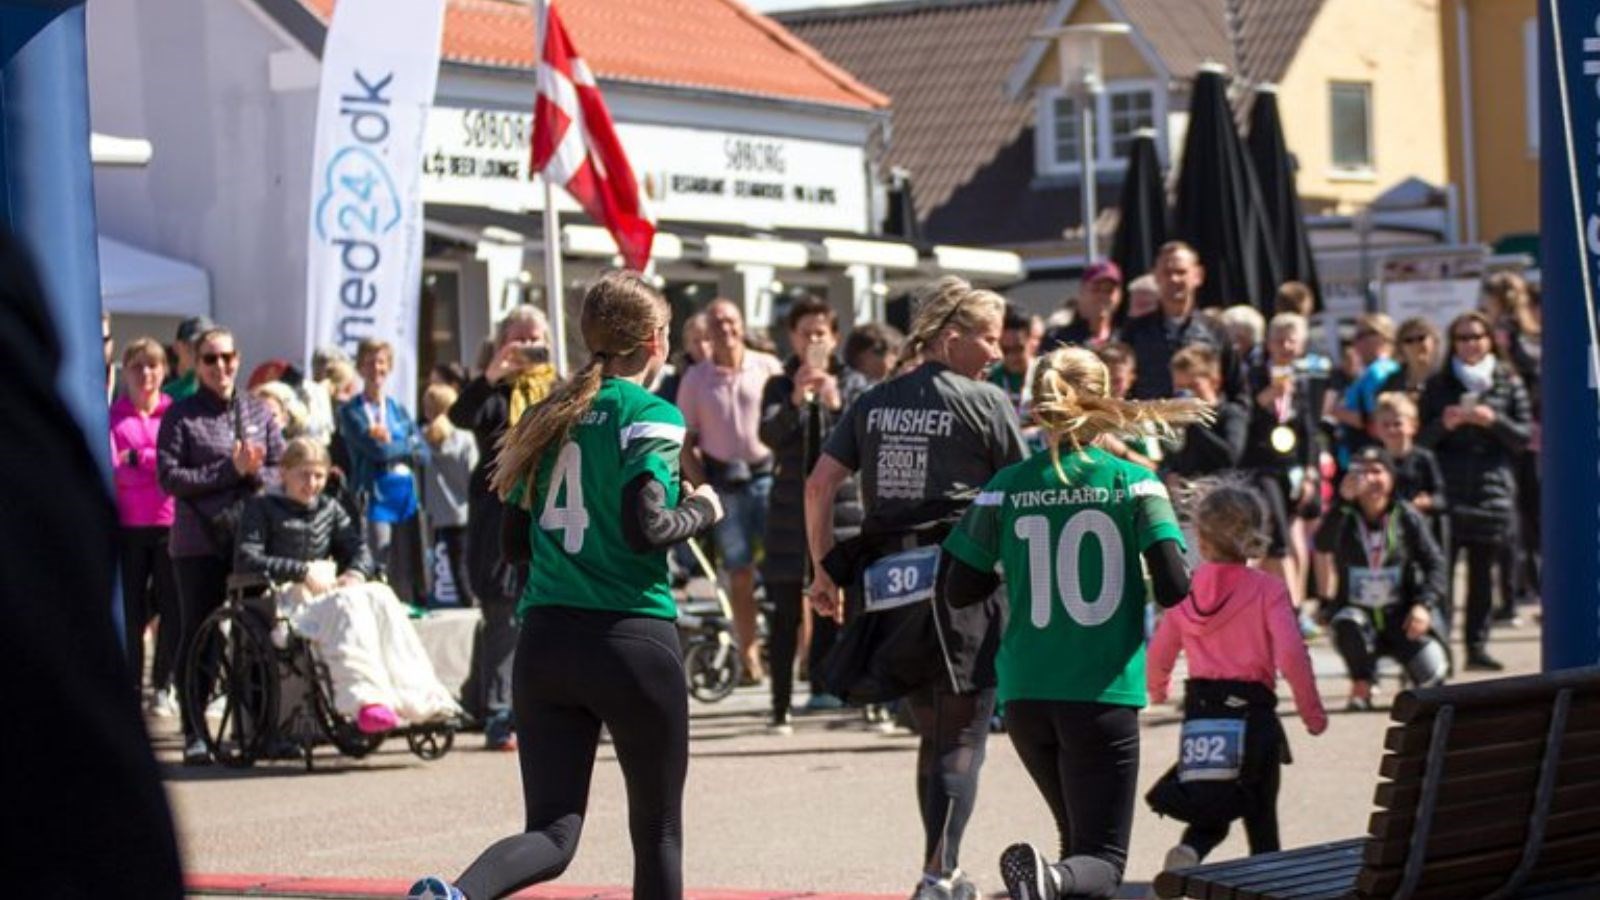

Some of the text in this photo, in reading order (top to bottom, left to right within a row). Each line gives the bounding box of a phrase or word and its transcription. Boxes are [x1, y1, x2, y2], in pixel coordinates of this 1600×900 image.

[462, 108, 529, 149] SØBOR
[866, 406, 954, 436] FINISHER
[878, 450, 928, 470] 2000 M
[539, 441, 590, 555] 4
[1010, 487, 1110, 508] VINGAARD
[887, 566, 919, 593] 30
[1014, 509, 1127, 629] 10
[1183, 735, 1226, 765] 392
